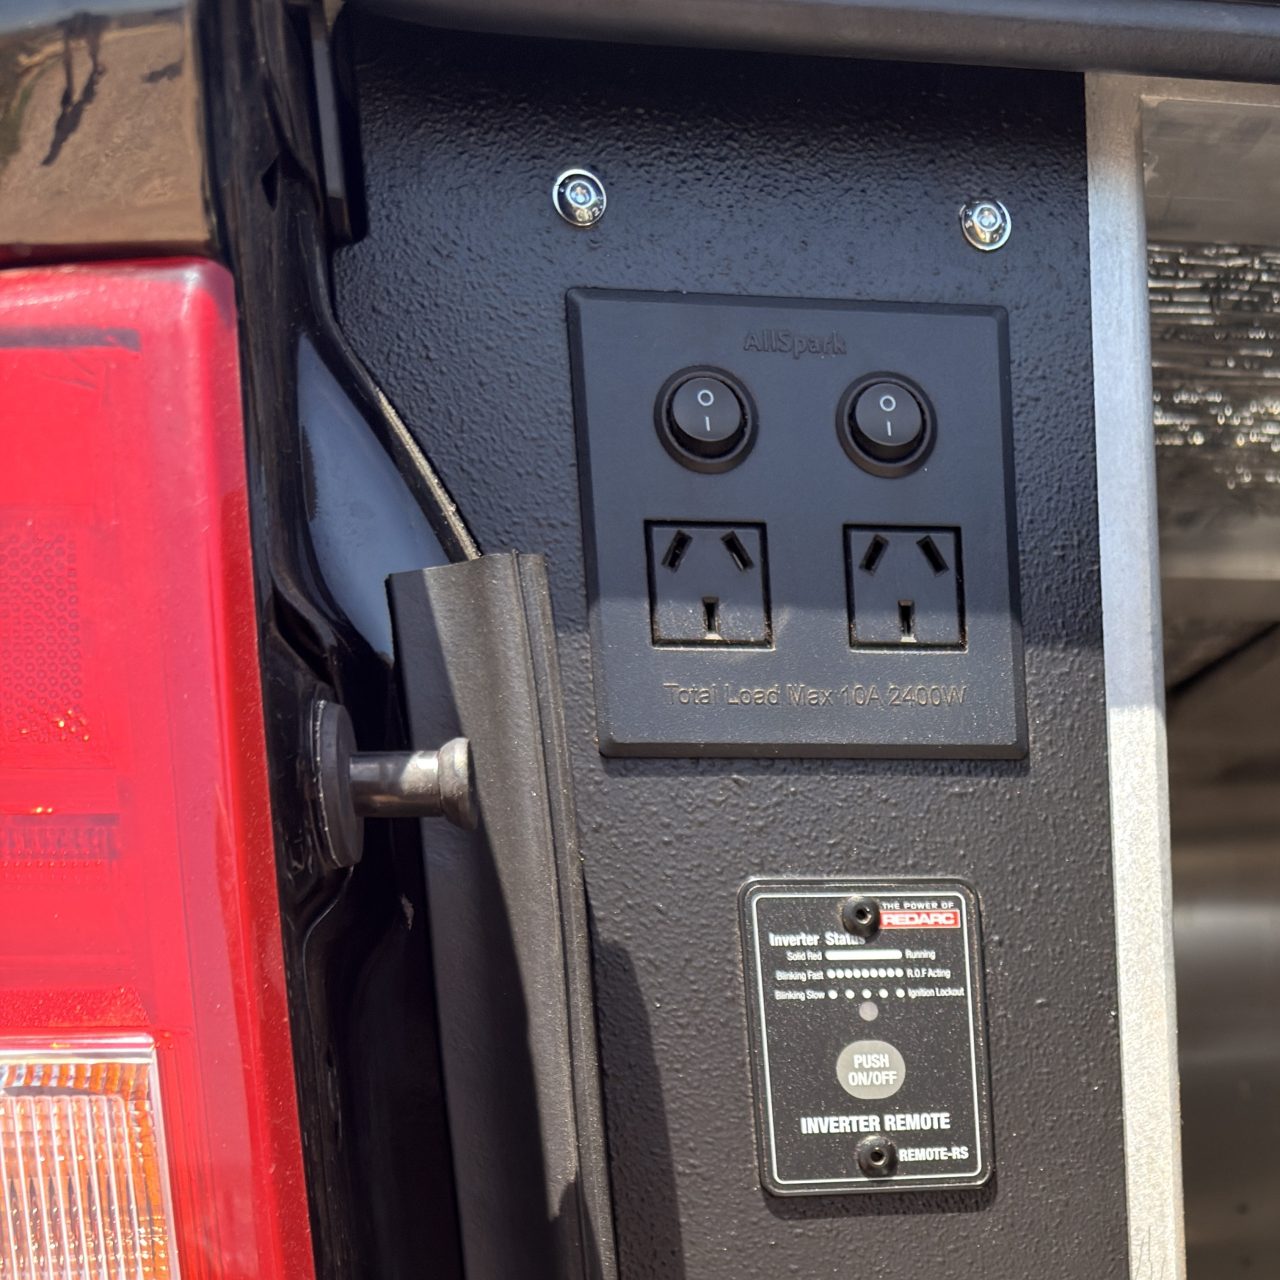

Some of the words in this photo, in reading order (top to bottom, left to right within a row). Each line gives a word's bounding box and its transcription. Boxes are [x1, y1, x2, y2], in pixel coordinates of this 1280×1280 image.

[743, 328, 848, 360] AllSpark
[662, 682, 717, 706] Total
[723, 682, 779, 706] Load
[785, 683, 834, 707] Max
[839, 683, 883, 707] 10A
[887, 683, 968, 707] 2400W
[882, 902, 900, 910] THE
[904, 901, 938, 910] POWER
[941, 901, 954, 909] OF
[882, 913, 955, 925] REDARC
[768, 932, 820, 947] Inverter
[785, 950, 806, 961] Solid
[807, 949, 822, 960] Red
[905, 949, 936, 960] Running
[775, 970, 806, 982] Blinking
[807, 969, 824, 980] Fast
[774, 989, 805, 1001] Blinking
[806, 988, 825, 999] Slow
[907, 987, 935, 999] Ignition
[935, 987, 965, 997] Lockout
[854, 1053, 890, 1068] PUSH
[848, 1070, 898, 1086] ON/OFF
[800, 1115, 881, 1134] INVERTER
[884, 1112, 951, 1131] REMOTE
[899, 1146, 969, 1162] REMOTE-RS
